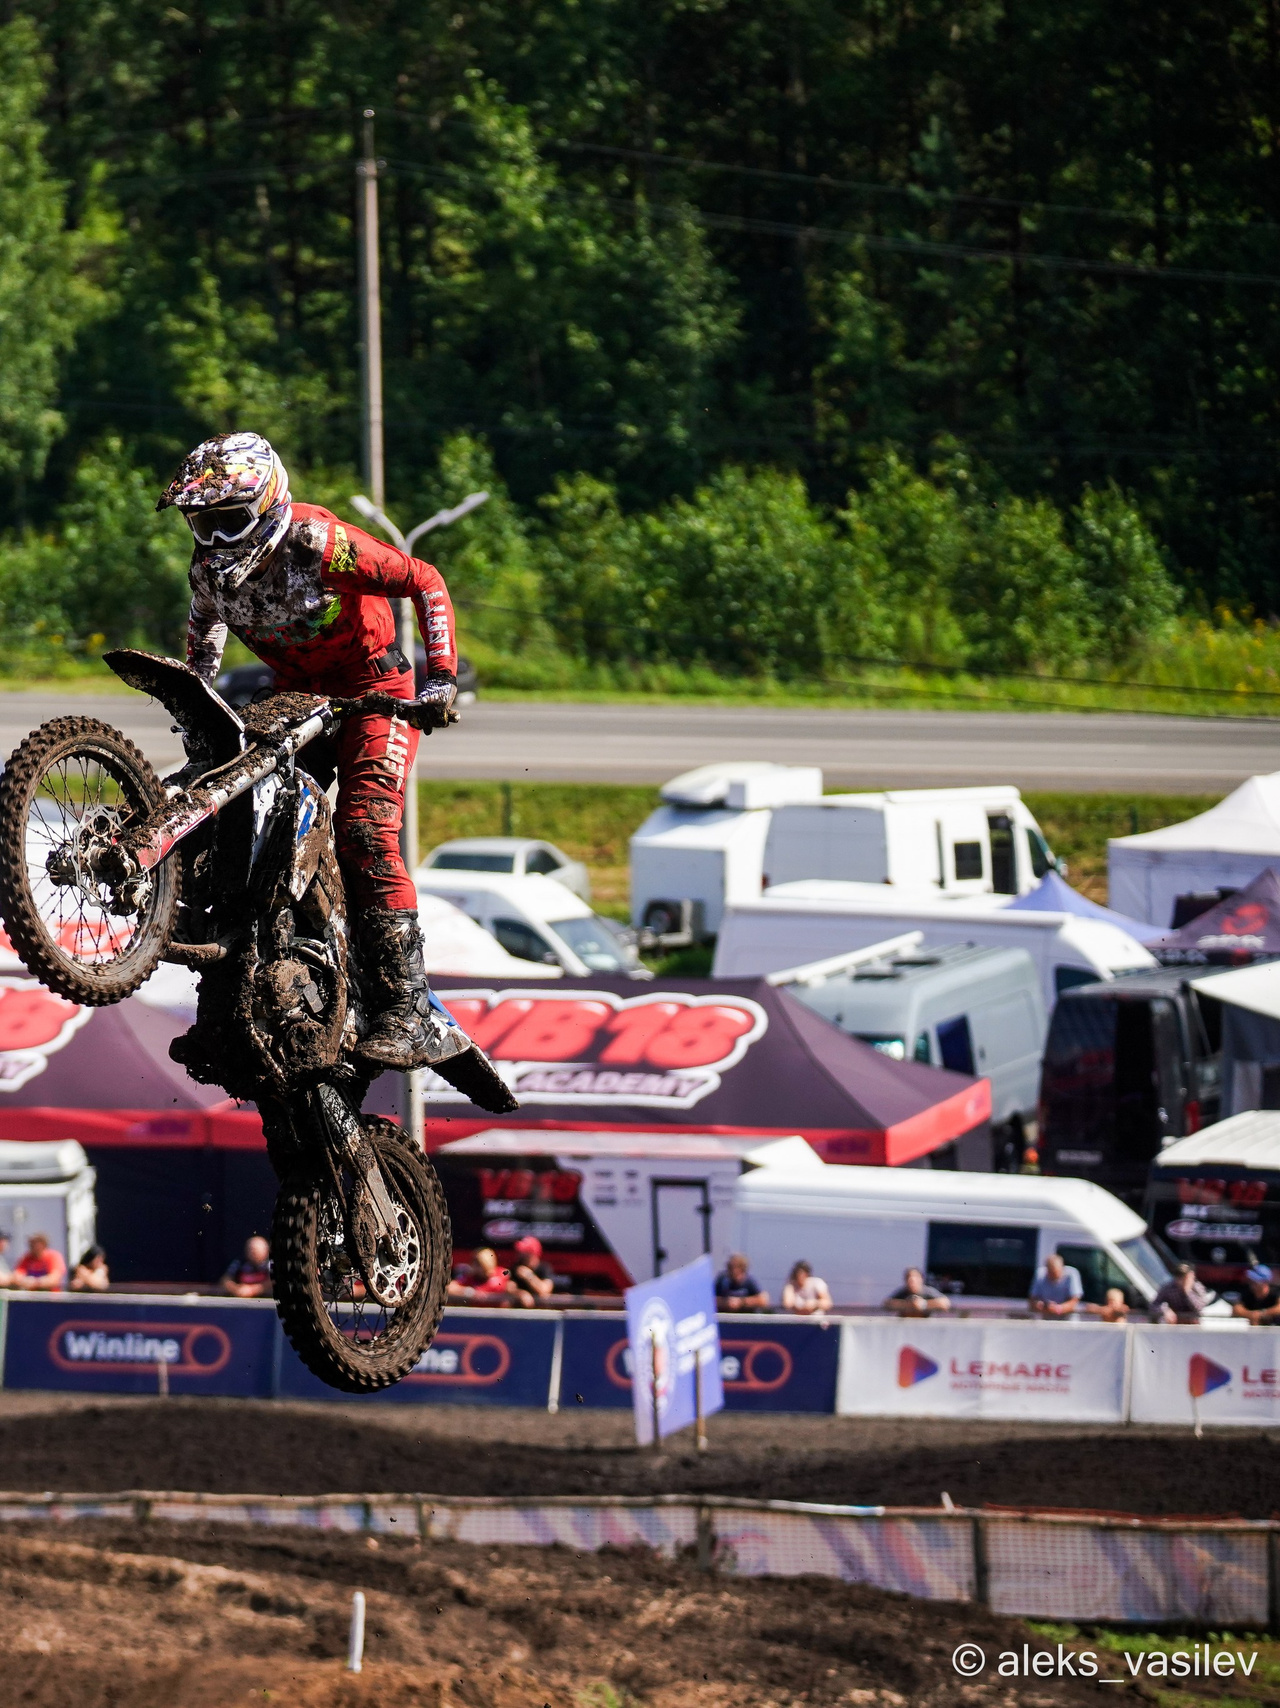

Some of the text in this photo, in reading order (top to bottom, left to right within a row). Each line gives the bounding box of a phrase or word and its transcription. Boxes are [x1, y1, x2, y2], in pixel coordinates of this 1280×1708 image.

[439, 998, 755, 1067] VB18
[515, 1070, 705, 1098] ACADEMY
[64, 1330, 180, 1363] Winline
[949, 1356, 1071, 1380] LEMARC
